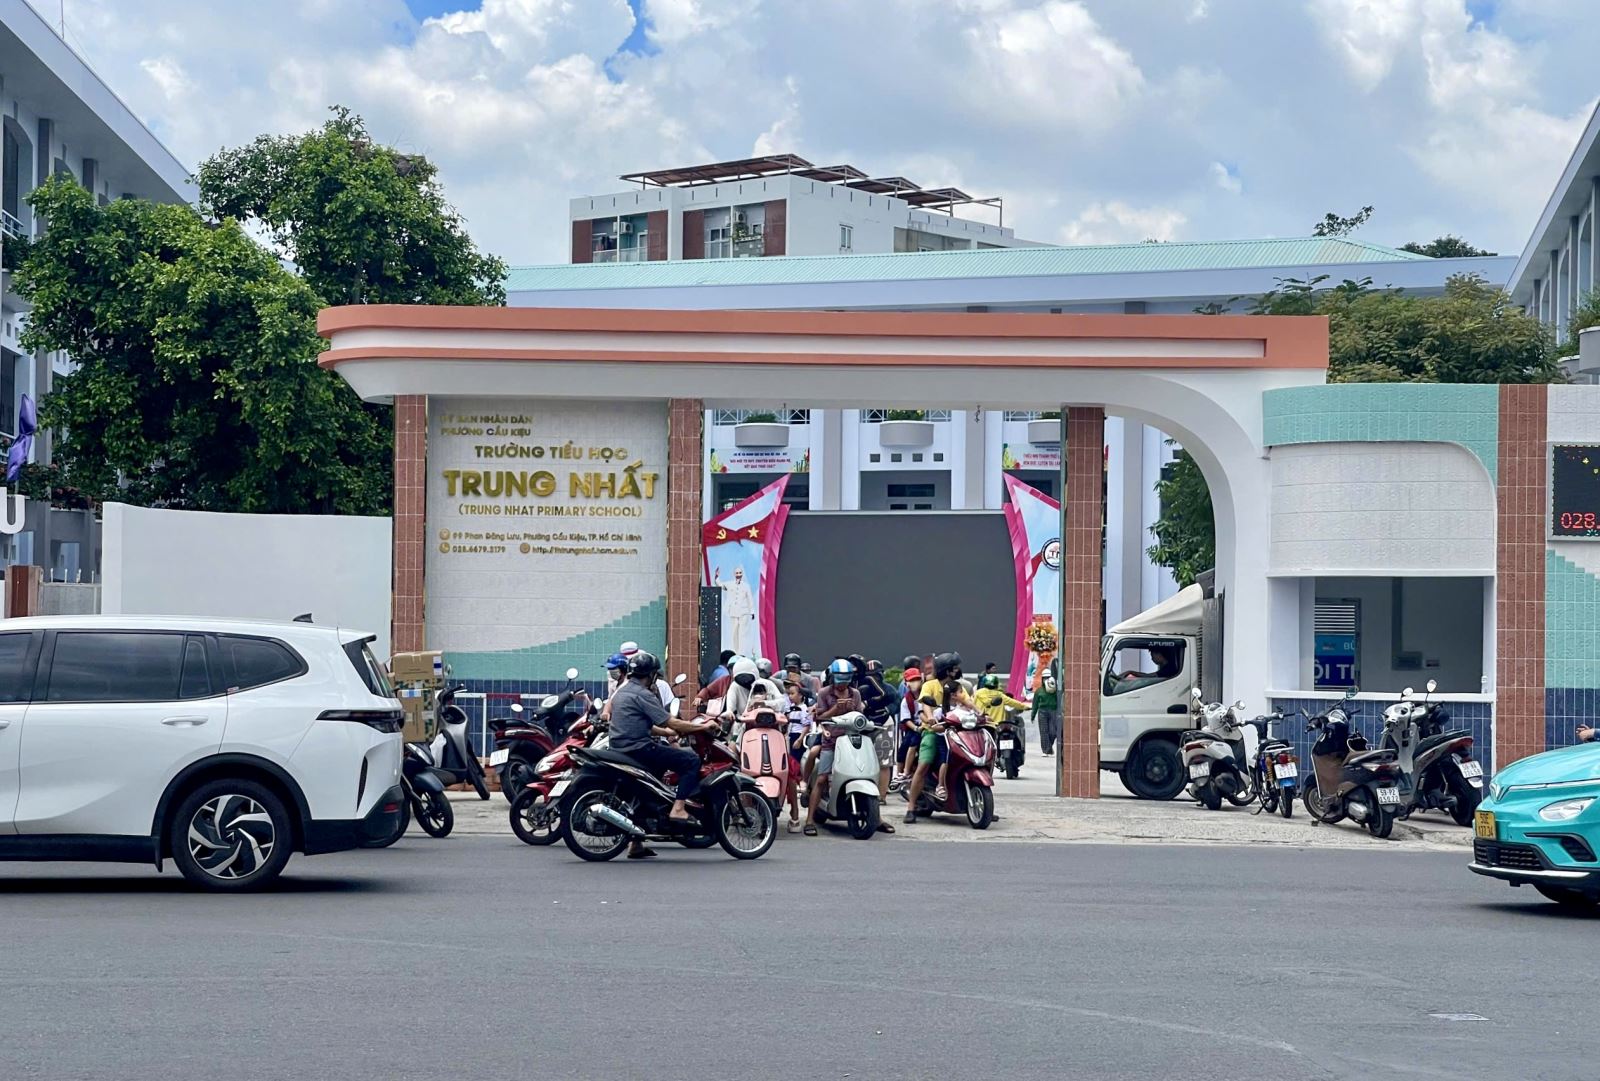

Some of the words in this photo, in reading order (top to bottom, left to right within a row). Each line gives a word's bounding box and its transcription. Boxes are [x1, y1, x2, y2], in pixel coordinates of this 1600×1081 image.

[475, 442, 545, 458] TRƯỜNG
[551, 440, 584, 459] TIỂU
[588, 447, 628, 463] HỌC
[442, 470, 557, 497] TRUNG
[569, 460, 658, 498] NHẤT
[458, 504, 501, 516] (TRUNG
[504, 505, 534, 516] NHAT
[537, 505, 586, 517] PRIMARY
[589, 505, 642, 518] SCHOOL)
